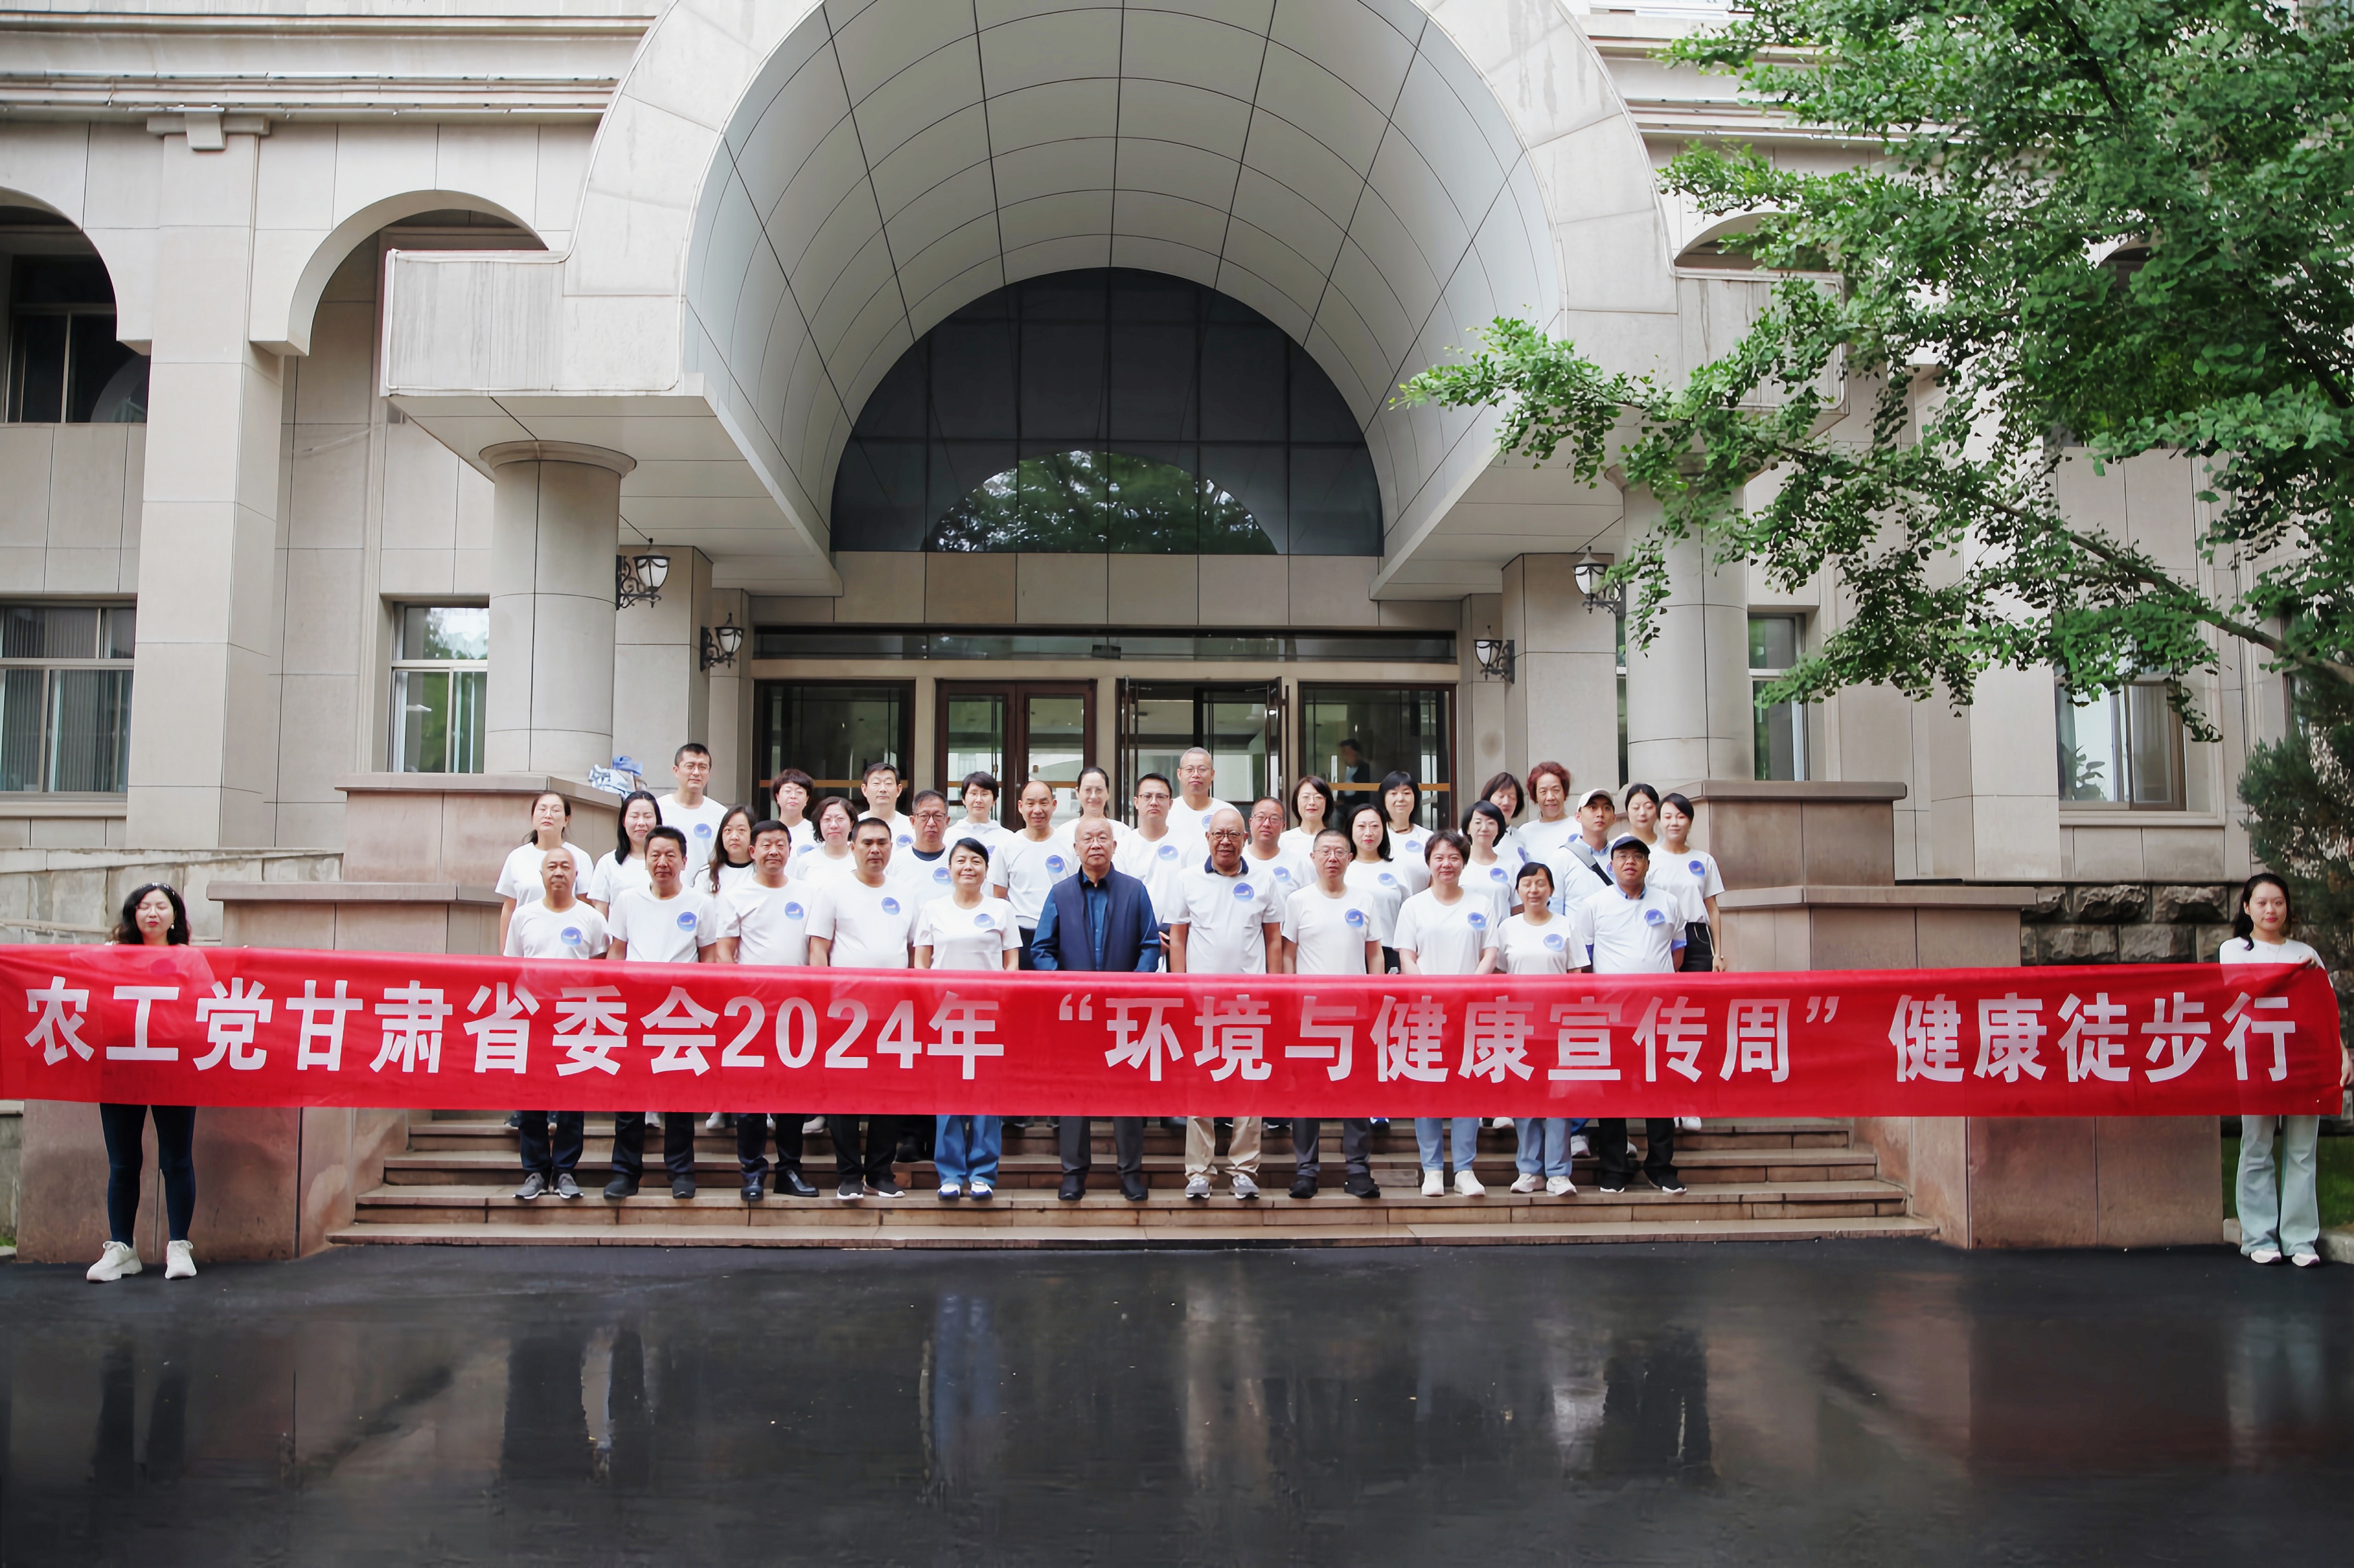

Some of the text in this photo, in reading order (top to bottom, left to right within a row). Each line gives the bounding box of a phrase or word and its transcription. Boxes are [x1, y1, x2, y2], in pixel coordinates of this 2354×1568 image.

[25, 976, 1004, 1080] 农工党甘肃省委会2024年
[1888, 992, 2295, 1083] 健康徒步行
